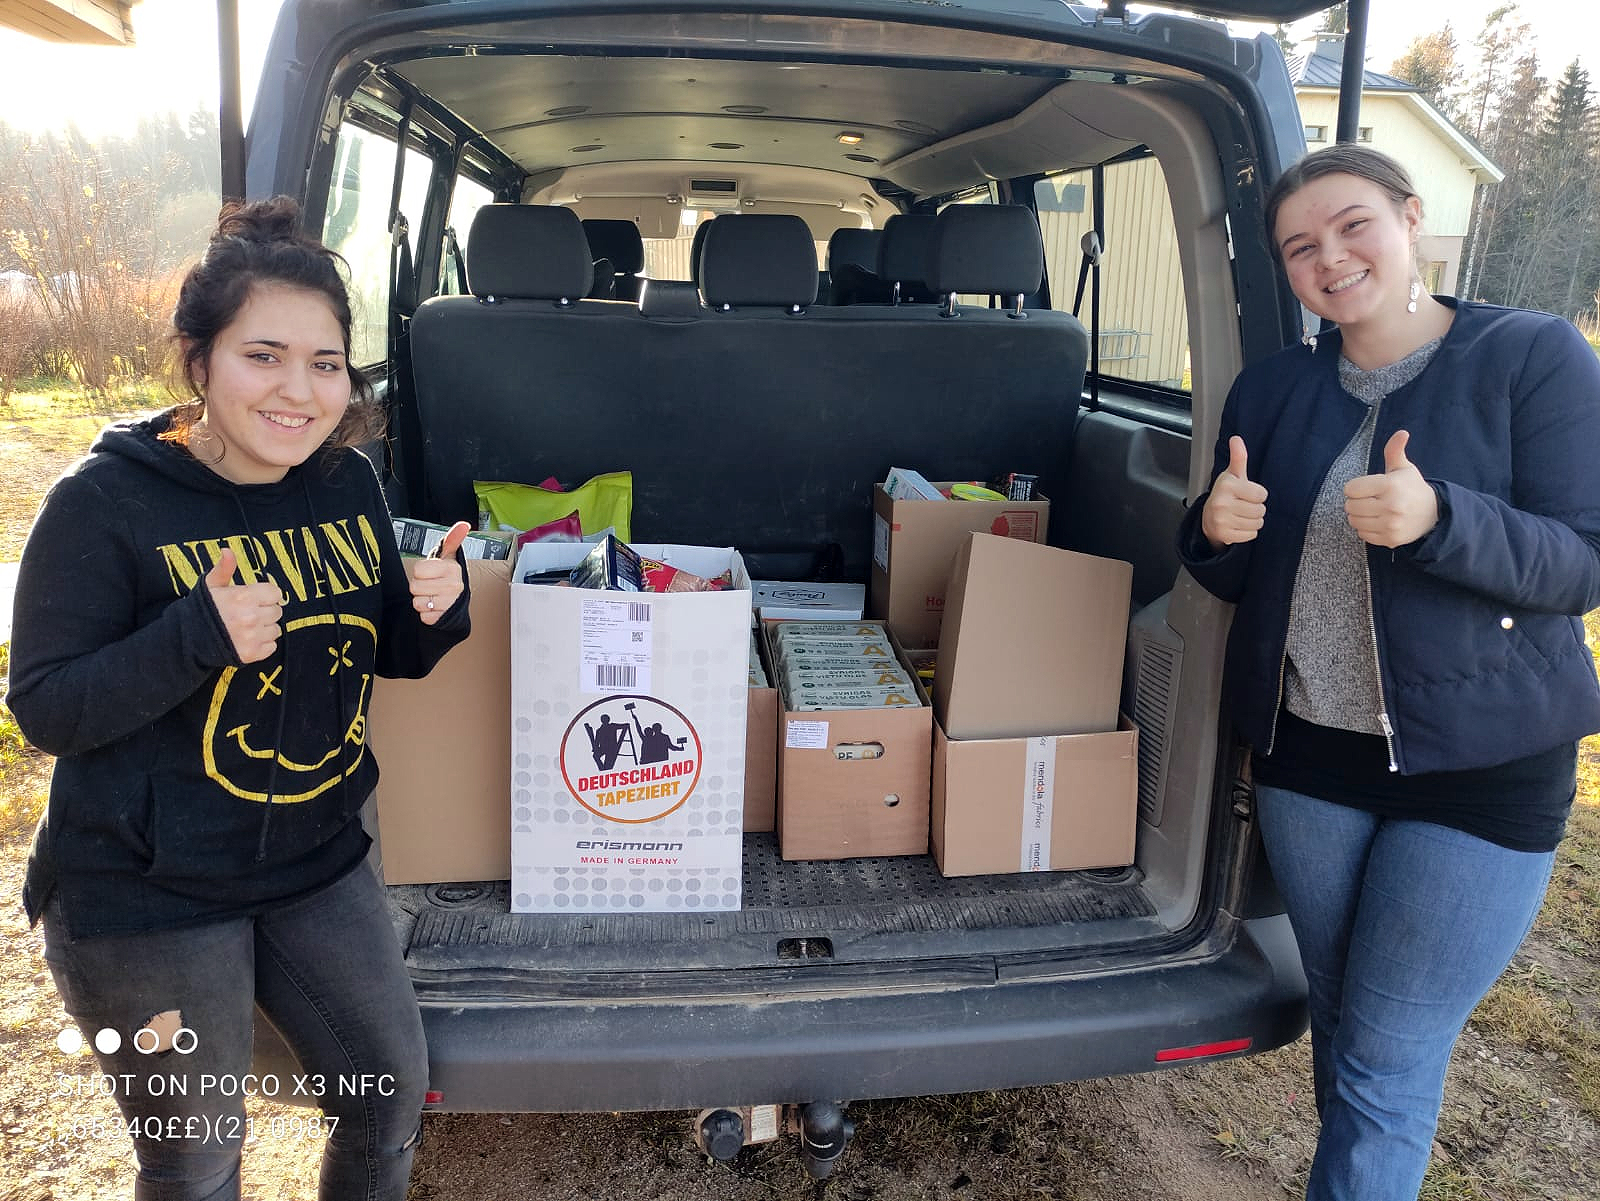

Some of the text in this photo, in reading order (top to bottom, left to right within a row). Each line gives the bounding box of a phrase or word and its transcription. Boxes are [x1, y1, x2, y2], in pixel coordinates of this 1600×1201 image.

[578, 759, 694, 792] DEUTSCHLAND
[1036, 761, 1045, 800] mendola
[596, 781, 681, 807] TAPEZIERT
[576, 840, 683, 851] erismann
[580, 857, 679, 865] MADE IN GERMANY
